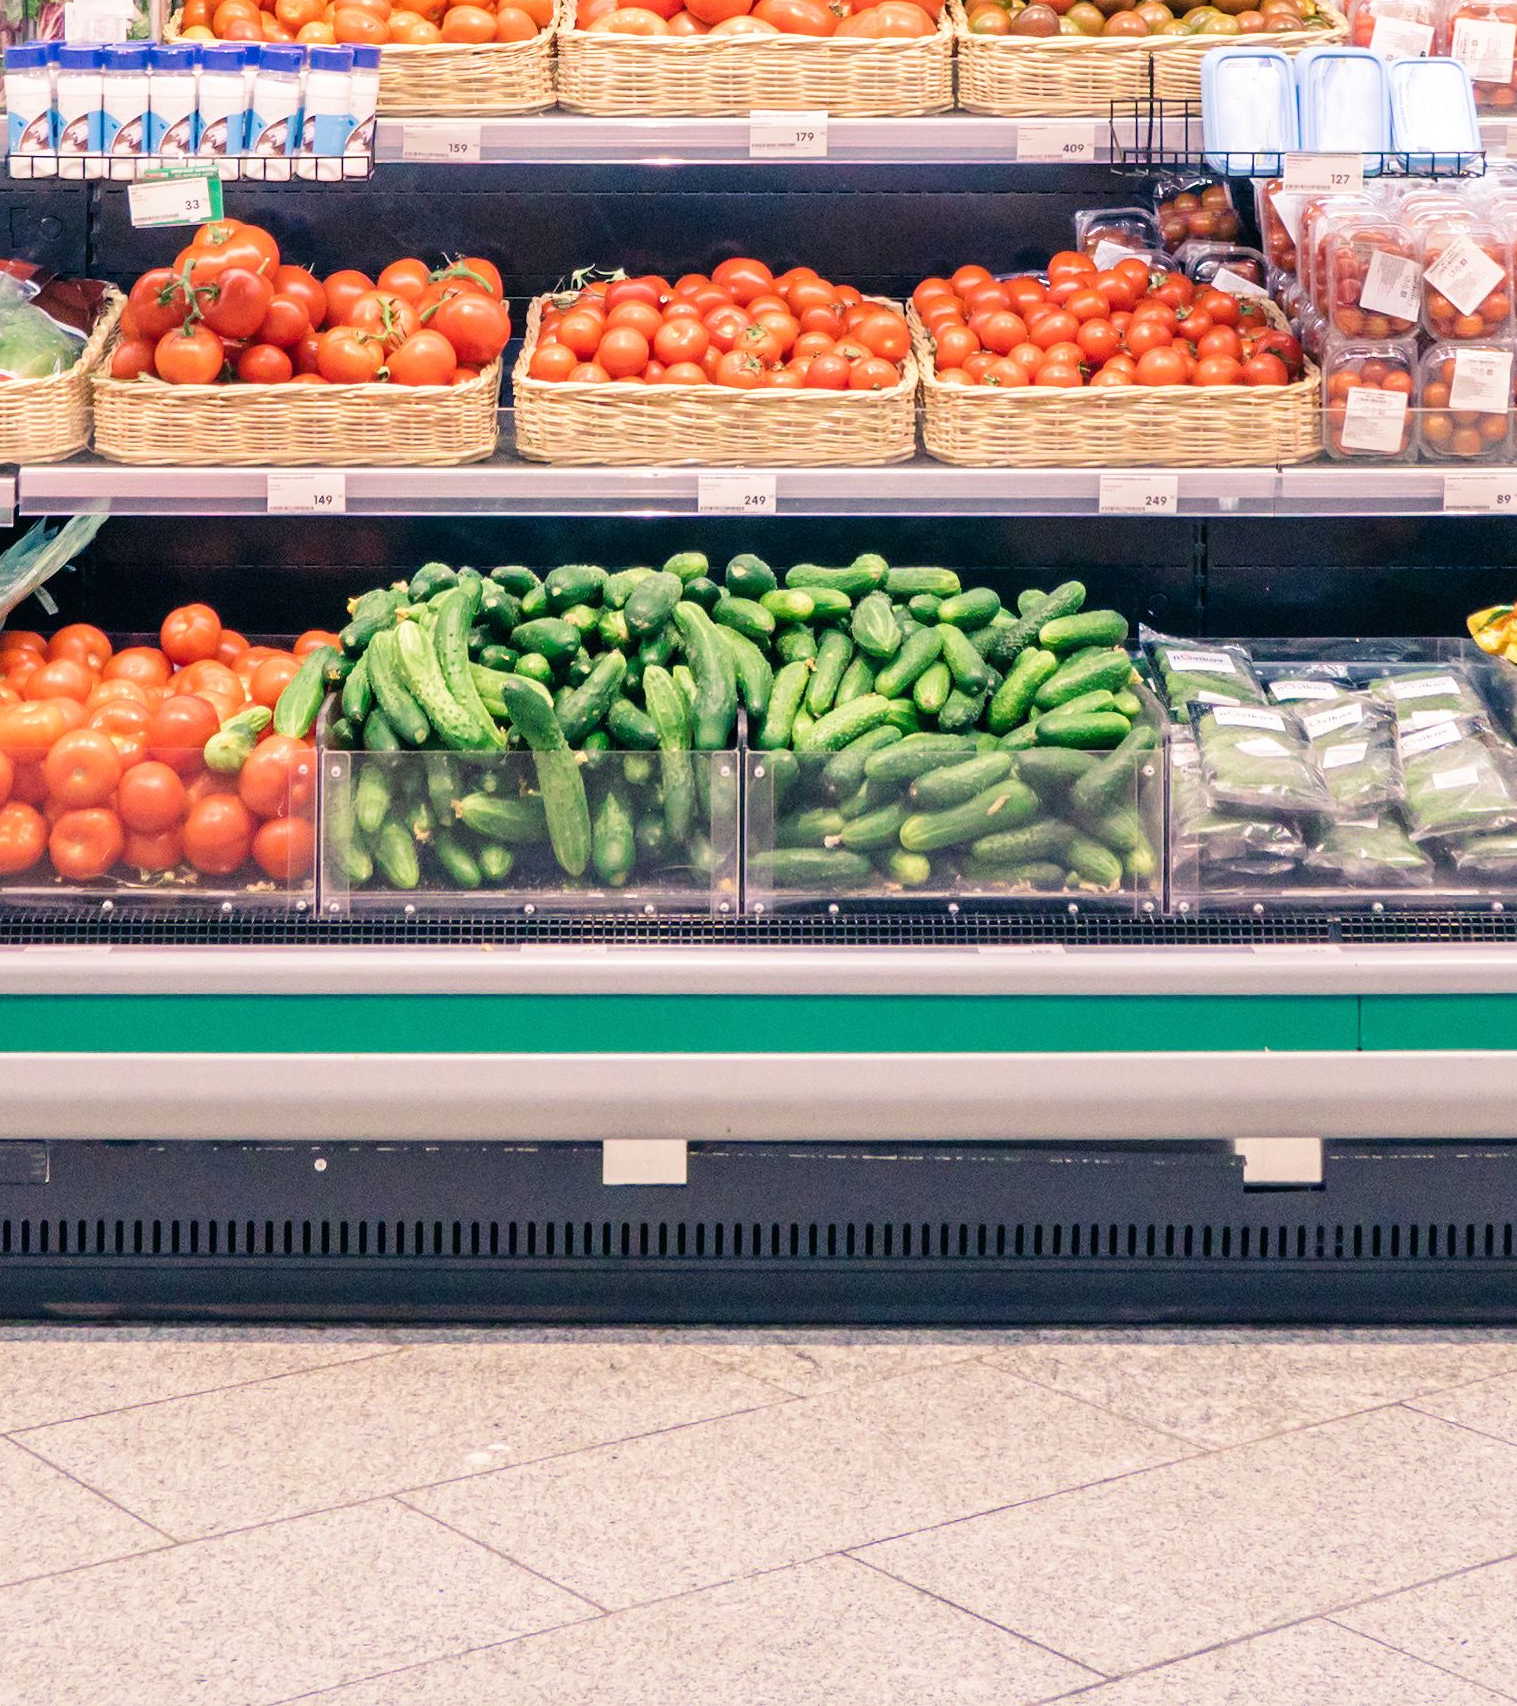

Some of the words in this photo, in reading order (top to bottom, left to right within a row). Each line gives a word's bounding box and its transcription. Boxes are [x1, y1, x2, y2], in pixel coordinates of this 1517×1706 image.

[795, 132, 814, 142] 179
[449, 143, 468, 153] 159
[1062, 143, 1085, 153] 409
[1331, 174, 1350, 184] 127
[185, 200, 200, 210] 33
[314, 495, 333, 505] 149
[744, 495, 766, 506] 249
[1145, 496, 1167, 506] 249
[1497, 494, 1511, 504] 89
